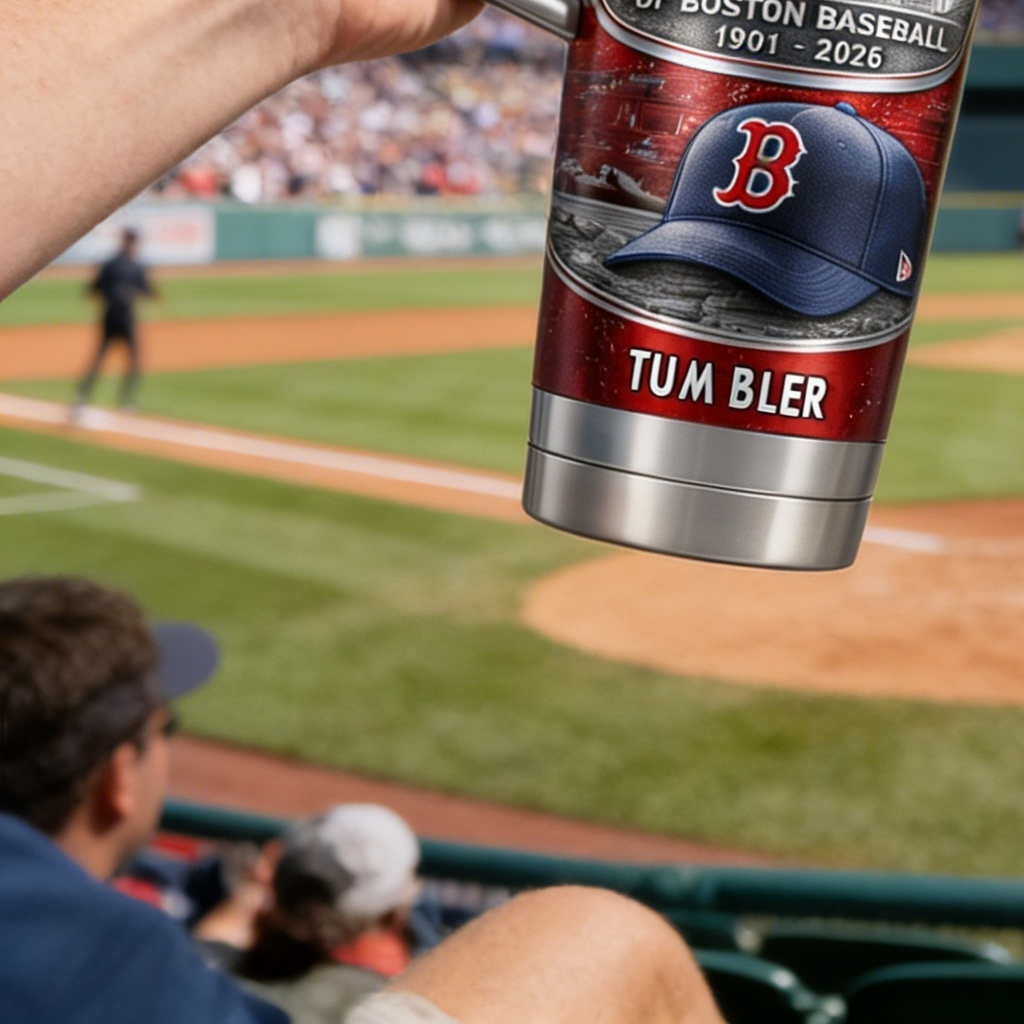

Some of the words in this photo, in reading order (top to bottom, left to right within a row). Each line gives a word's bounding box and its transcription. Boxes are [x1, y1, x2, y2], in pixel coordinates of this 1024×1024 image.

[714, 25, 779, 55] 1901
[814, 39, 883, 69] 2026
[816, 6, 949, 53] BASEBALL
[712, 117, 808, 213] B
[628, 349, 714, 405] TUM
[728, 366, 828, 420] BLER
